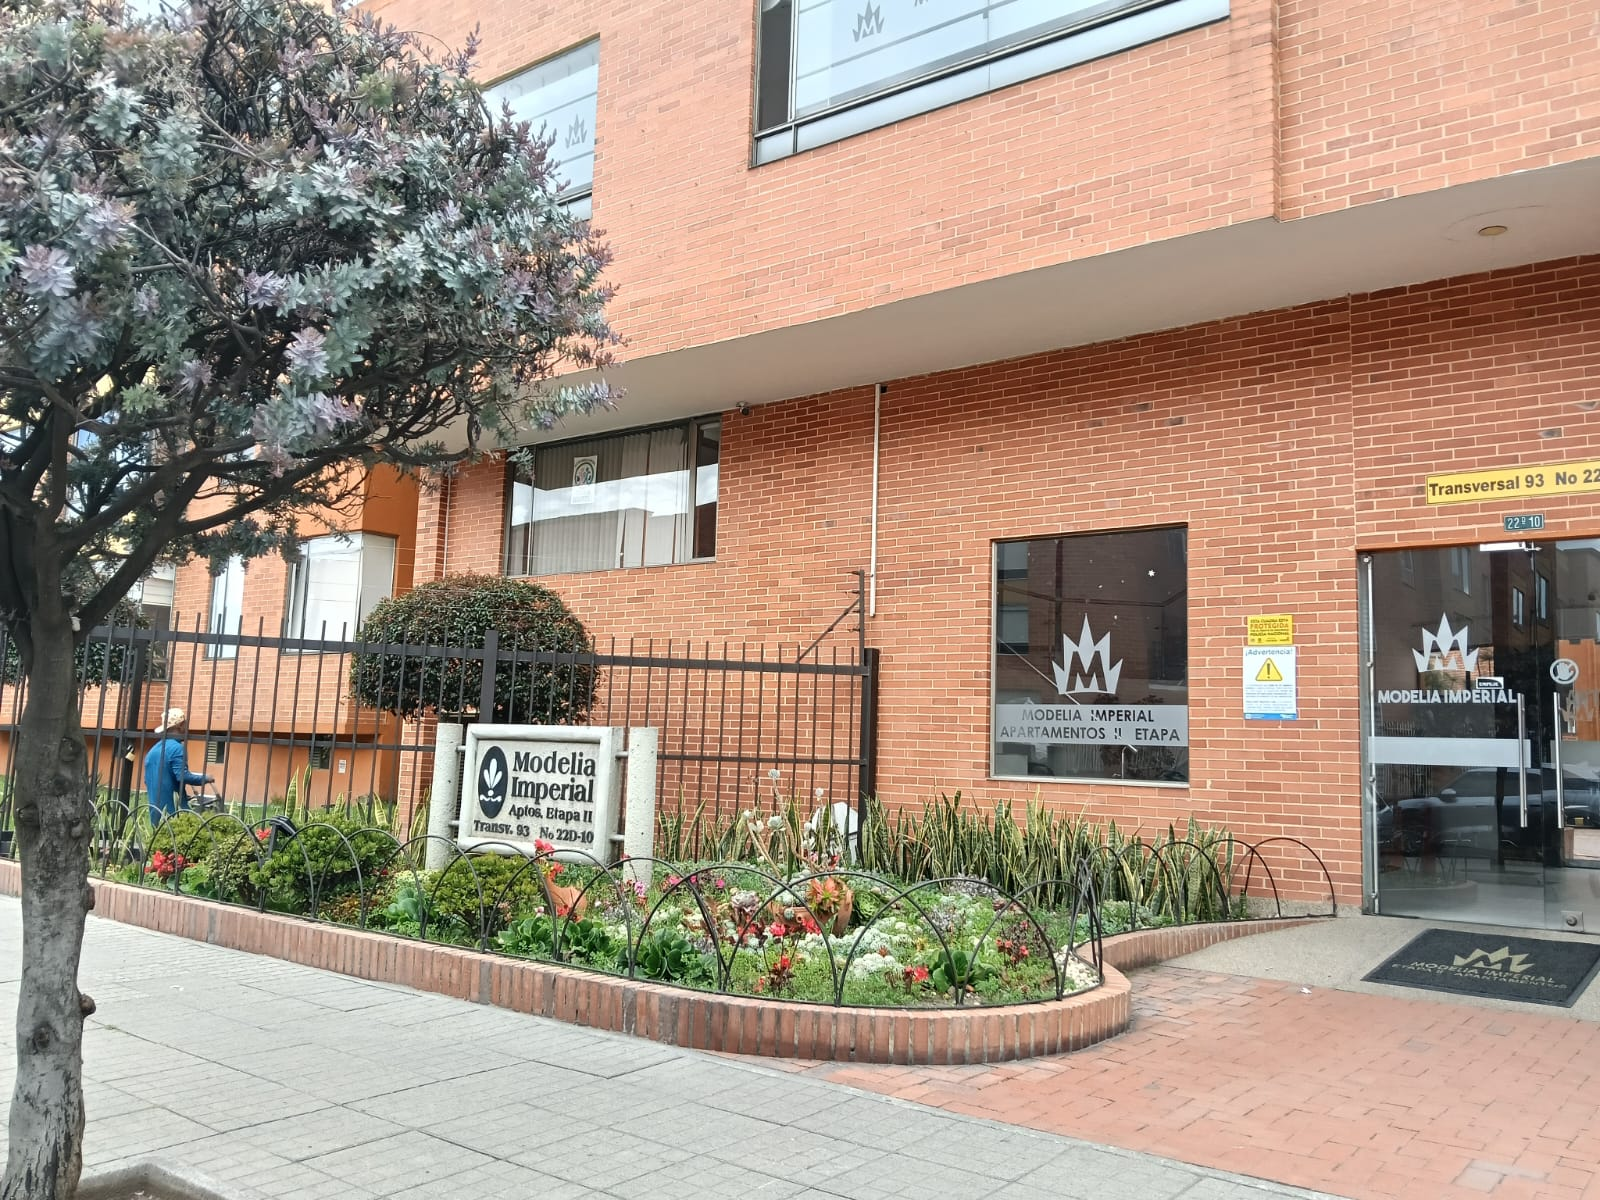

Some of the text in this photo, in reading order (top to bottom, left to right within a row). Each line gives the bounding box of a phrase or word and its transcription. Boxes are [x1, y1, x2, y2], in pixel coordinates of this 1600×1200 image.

[1429, 476, 1520, 496] Transversal
[1525, 473, 1544, 488] 93
[1555, 471, 1577, 486] No
[1528, 516, 1541, 528] 10
[1245, 648, 1293, 656] ¡Advertencia!
[1378, 688, 1517, 704] MODELIA IMPERIAL
[1022, 709, 1154, 722] MODELIA IMPERIAL
[1000, 726, 1105, 739] APARTAMENTOS
[1135, 727, 1180, 741] ETAPA
[512, 751, 596, 777] Modelia
[511, 776, 594, 805] Imperial
[509, 804, 593, 824] Aptos. Etapa II
[474, 820, 594, 844] Transv. 93 No 22D-10
[1410, 961, 1555, 984] MODELIA IMPERIAL
